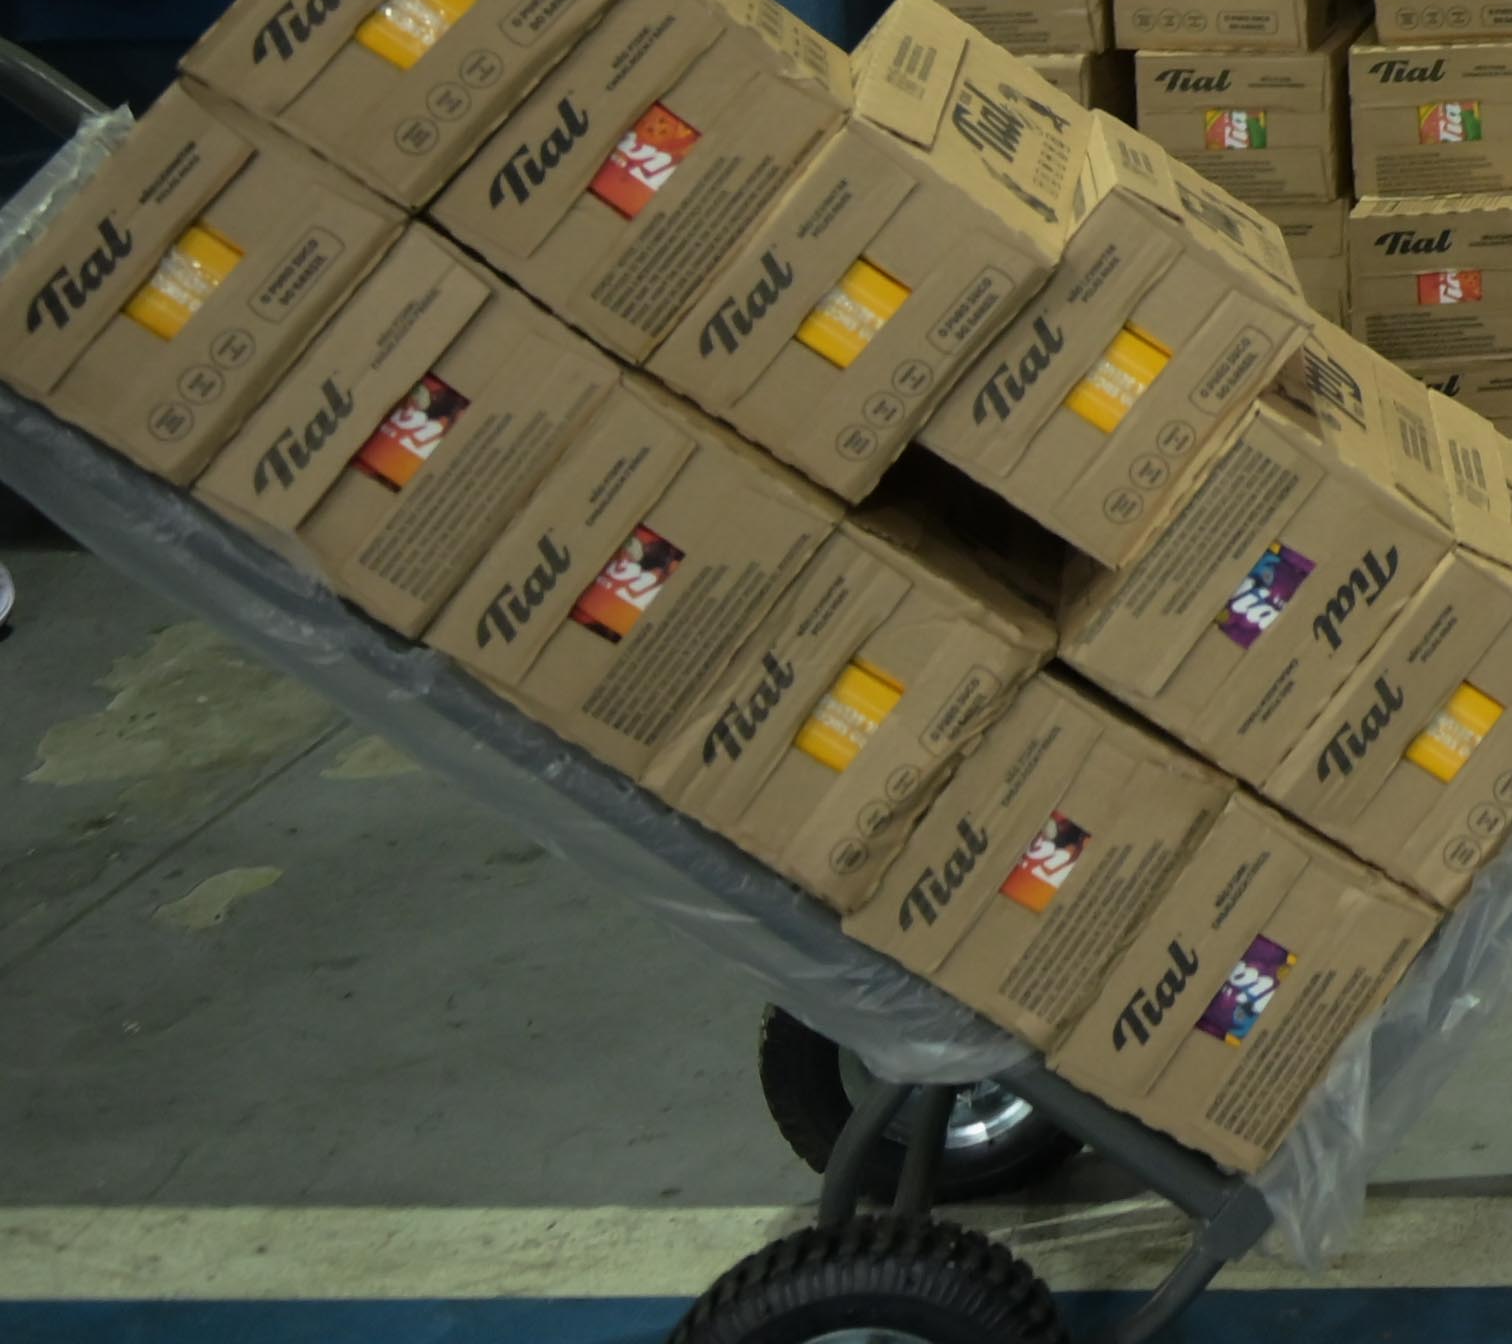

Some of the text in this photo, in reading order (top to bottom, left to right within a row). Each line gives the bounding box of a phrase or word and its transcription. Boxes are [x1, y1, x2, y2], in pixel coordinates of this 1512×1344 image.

[1155, 69, 1231, 92] Tial
[1368, 59, 1445, 83] Tial
[489, 99, 590, 209] Tial
[27, 218, 133, 335] Tial
[699, 251, 794, 359] Tial
[972, 315, 1065, 427] Tial
[254, 378, 352, 496] Tial
[476, 534, 571, 649] Tial
[1313, 546, 1398, 651] Tial
[703, 650, 795, 767] Tial
[1317, 677, 1404, 783] Tial
[899, 818, 988, 932] Tial
[1112, 940, 1199, 1052] Tial
